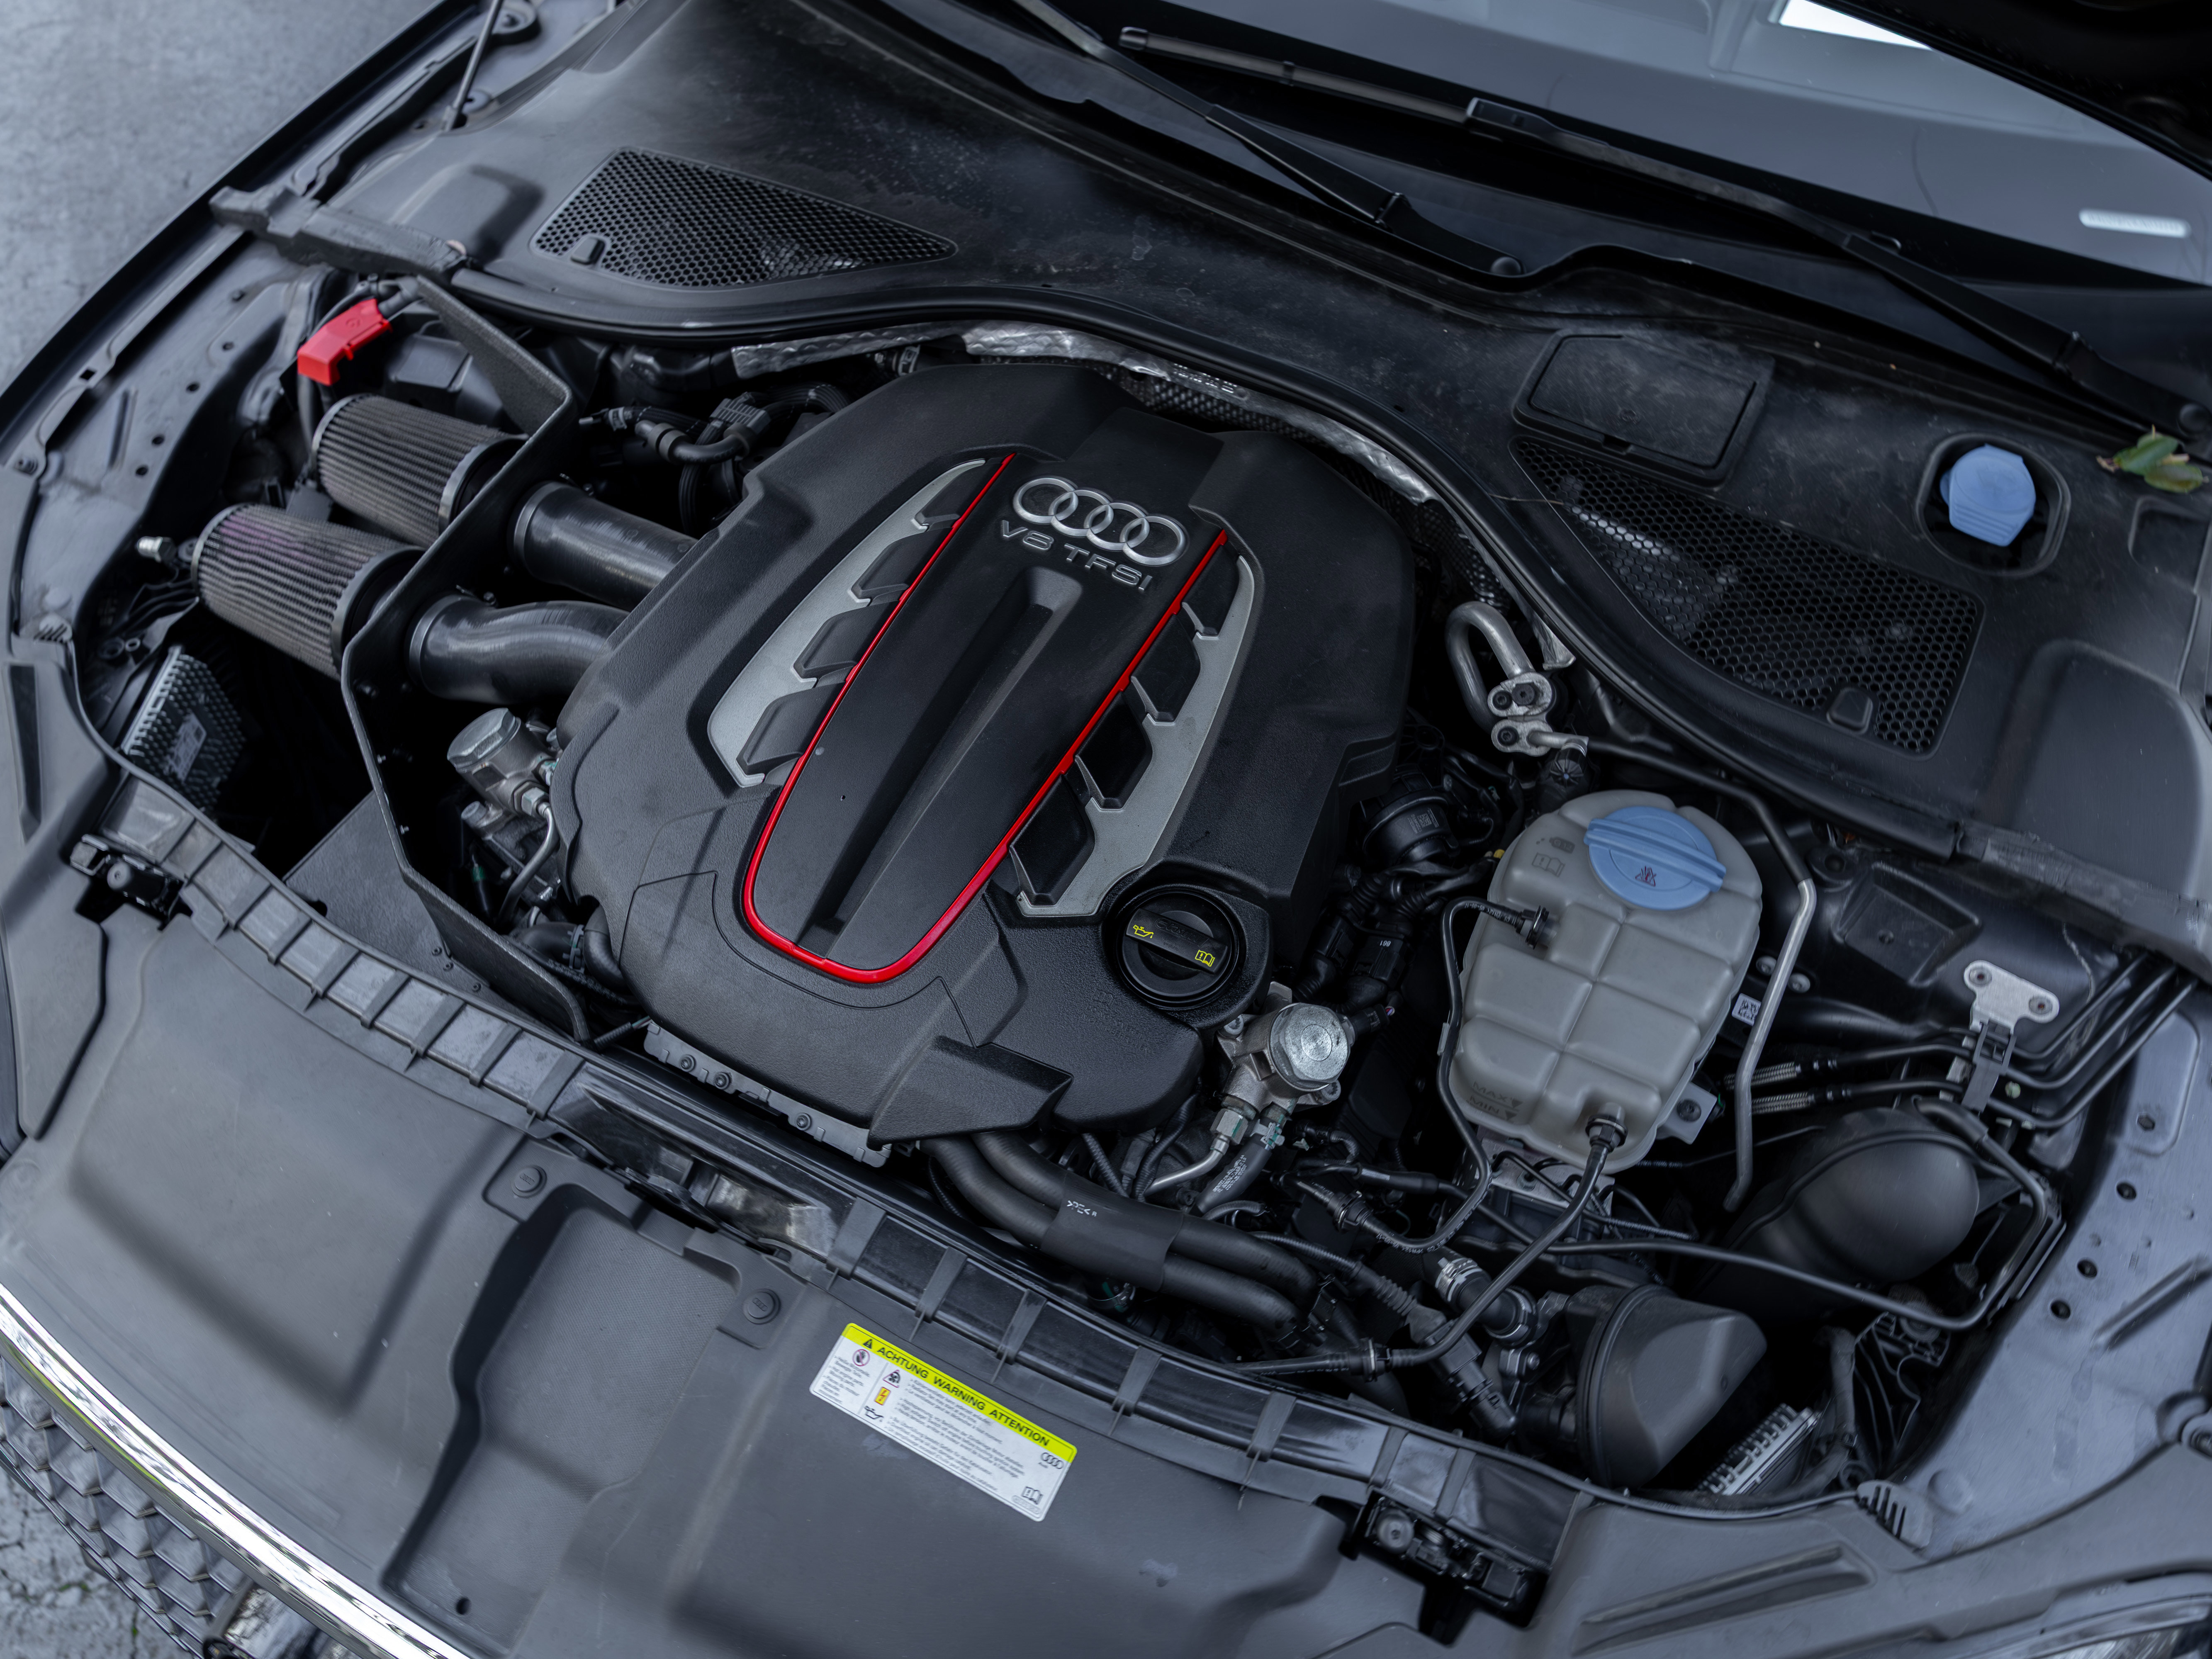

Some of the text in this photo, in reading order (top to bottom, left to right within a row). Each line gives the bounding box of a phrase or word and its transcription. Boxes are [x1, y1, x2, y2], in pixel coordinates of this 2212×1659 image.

[1001, 520, 1153, 591] V8 TFSI
[1470, 1098, 1500, 1113] MIN
[1473, 1082, 1509, 1101] MAX
[876, 1346, 929, 1379] ACHTUNG
[933, 1377, 986, 1411] WARNING
[989, 1409, 1050, 1446] ATTENTION
